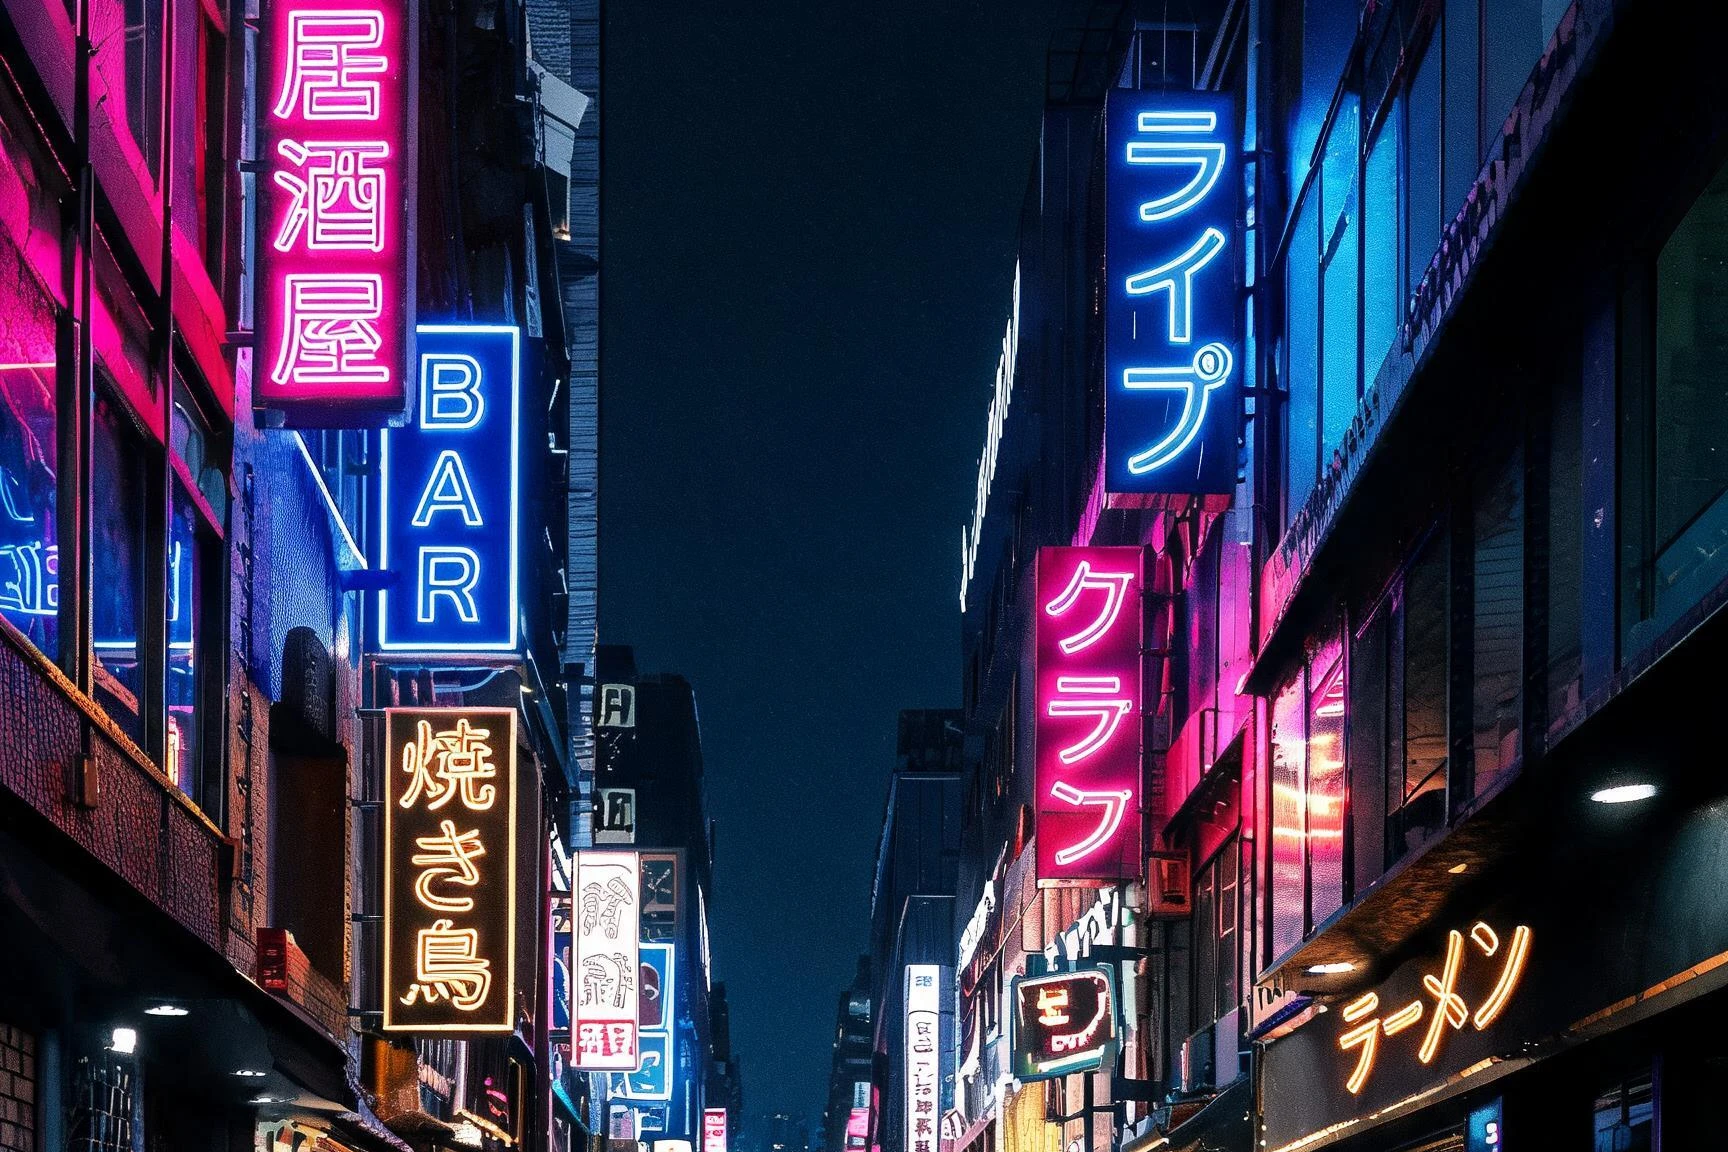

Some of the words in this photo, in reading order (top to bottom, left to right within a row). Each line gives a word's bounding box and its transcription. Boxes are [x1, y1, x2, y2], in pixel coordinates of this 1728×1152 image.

[272, 9, 389, 385] 居酒屋
[410, 352, 486, 625] BAR
[399, 717, 497, 1012] 焼き鳥
